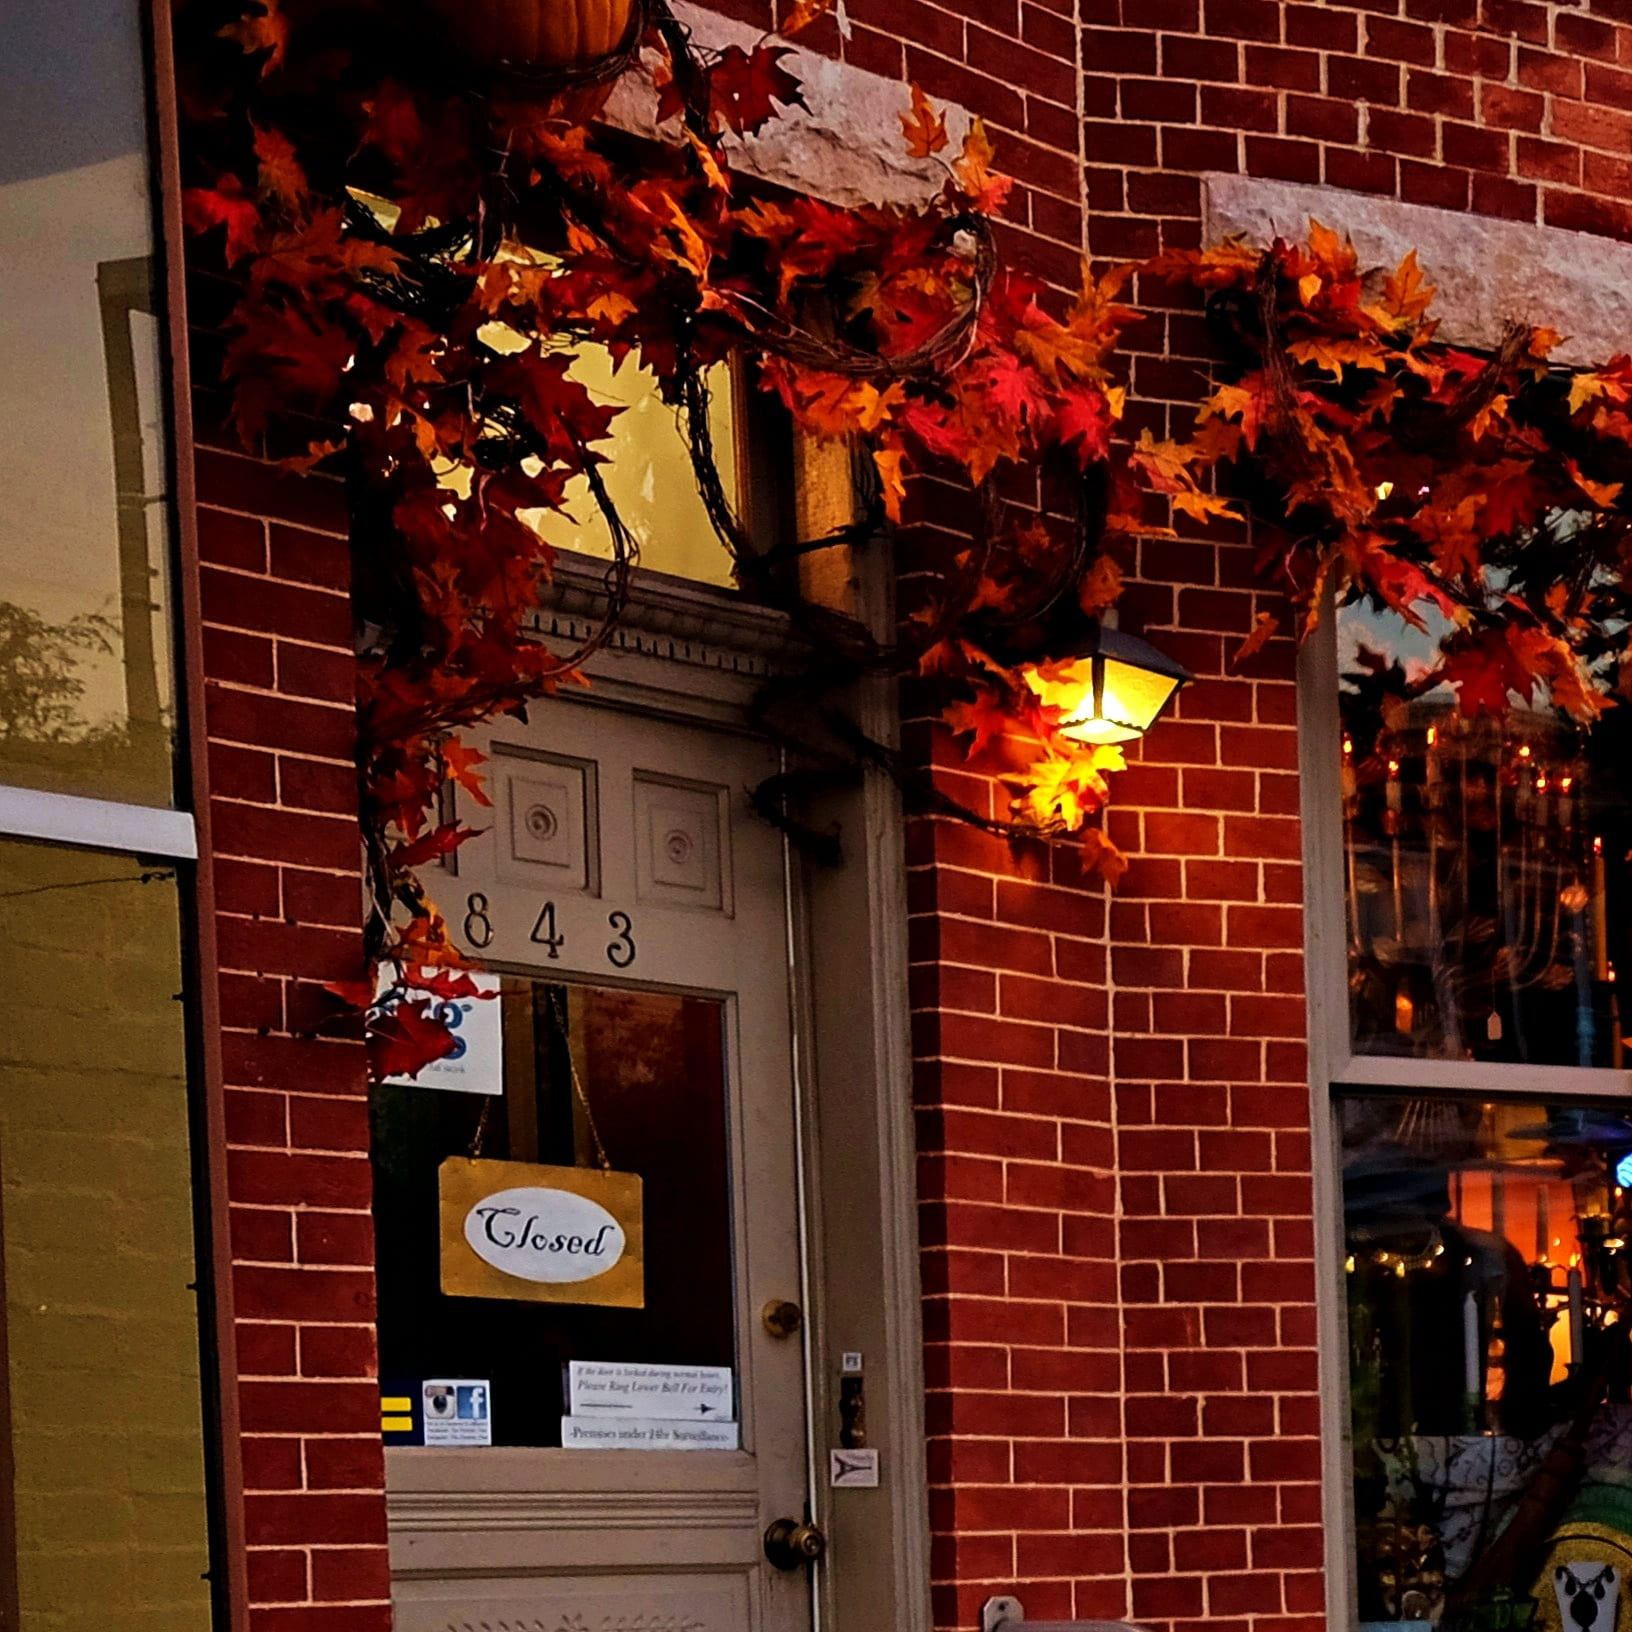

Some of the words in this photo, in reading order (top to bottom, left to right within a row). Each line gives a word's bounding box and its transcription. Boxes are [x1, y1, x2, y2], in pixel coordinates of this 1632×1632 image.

[463, 892, 637, 969] 843
[475, 1204, 617, 1258] Closed
[577, 1379, 606, 1391] Please
[609, 1380, 629, 1394] Ring
[661, 1382, 680, 1393] Bell
[681, 1382, 698, 1394] For
